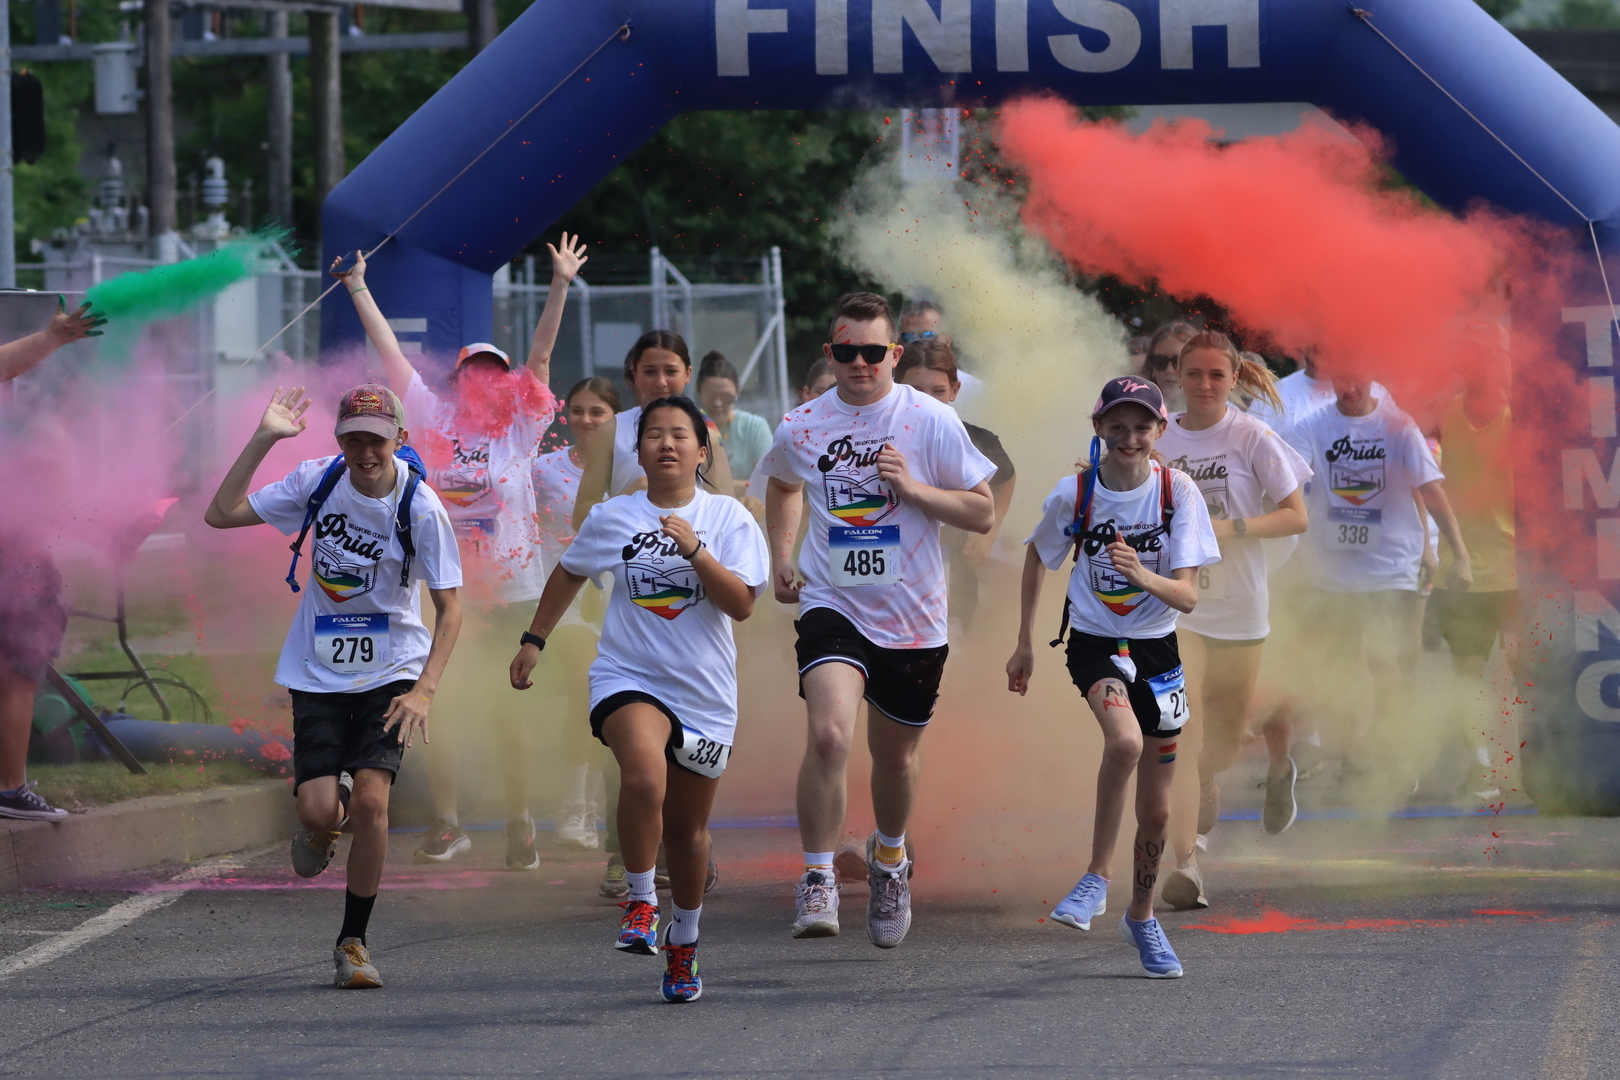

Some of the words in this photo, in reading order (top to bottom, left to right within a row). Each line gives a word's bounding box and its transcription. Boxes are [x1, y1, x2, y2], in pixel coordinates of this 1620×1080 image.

[715, 0, 1261, 77] FINISH
[818, 434, 885, 473] Prid
[1325, 435, 1387, 463] Pride
[316, 513, 384, 561] Pride
[347, 522, 373, 537] BRADFORD
[1337, 524, 1369, 545] 338
[843, 549, 886, 576] 485
[332, 636, 374, 663] 279
[1169, 686, 1189, 720] 27
[688, 738, 724, 769] 334
